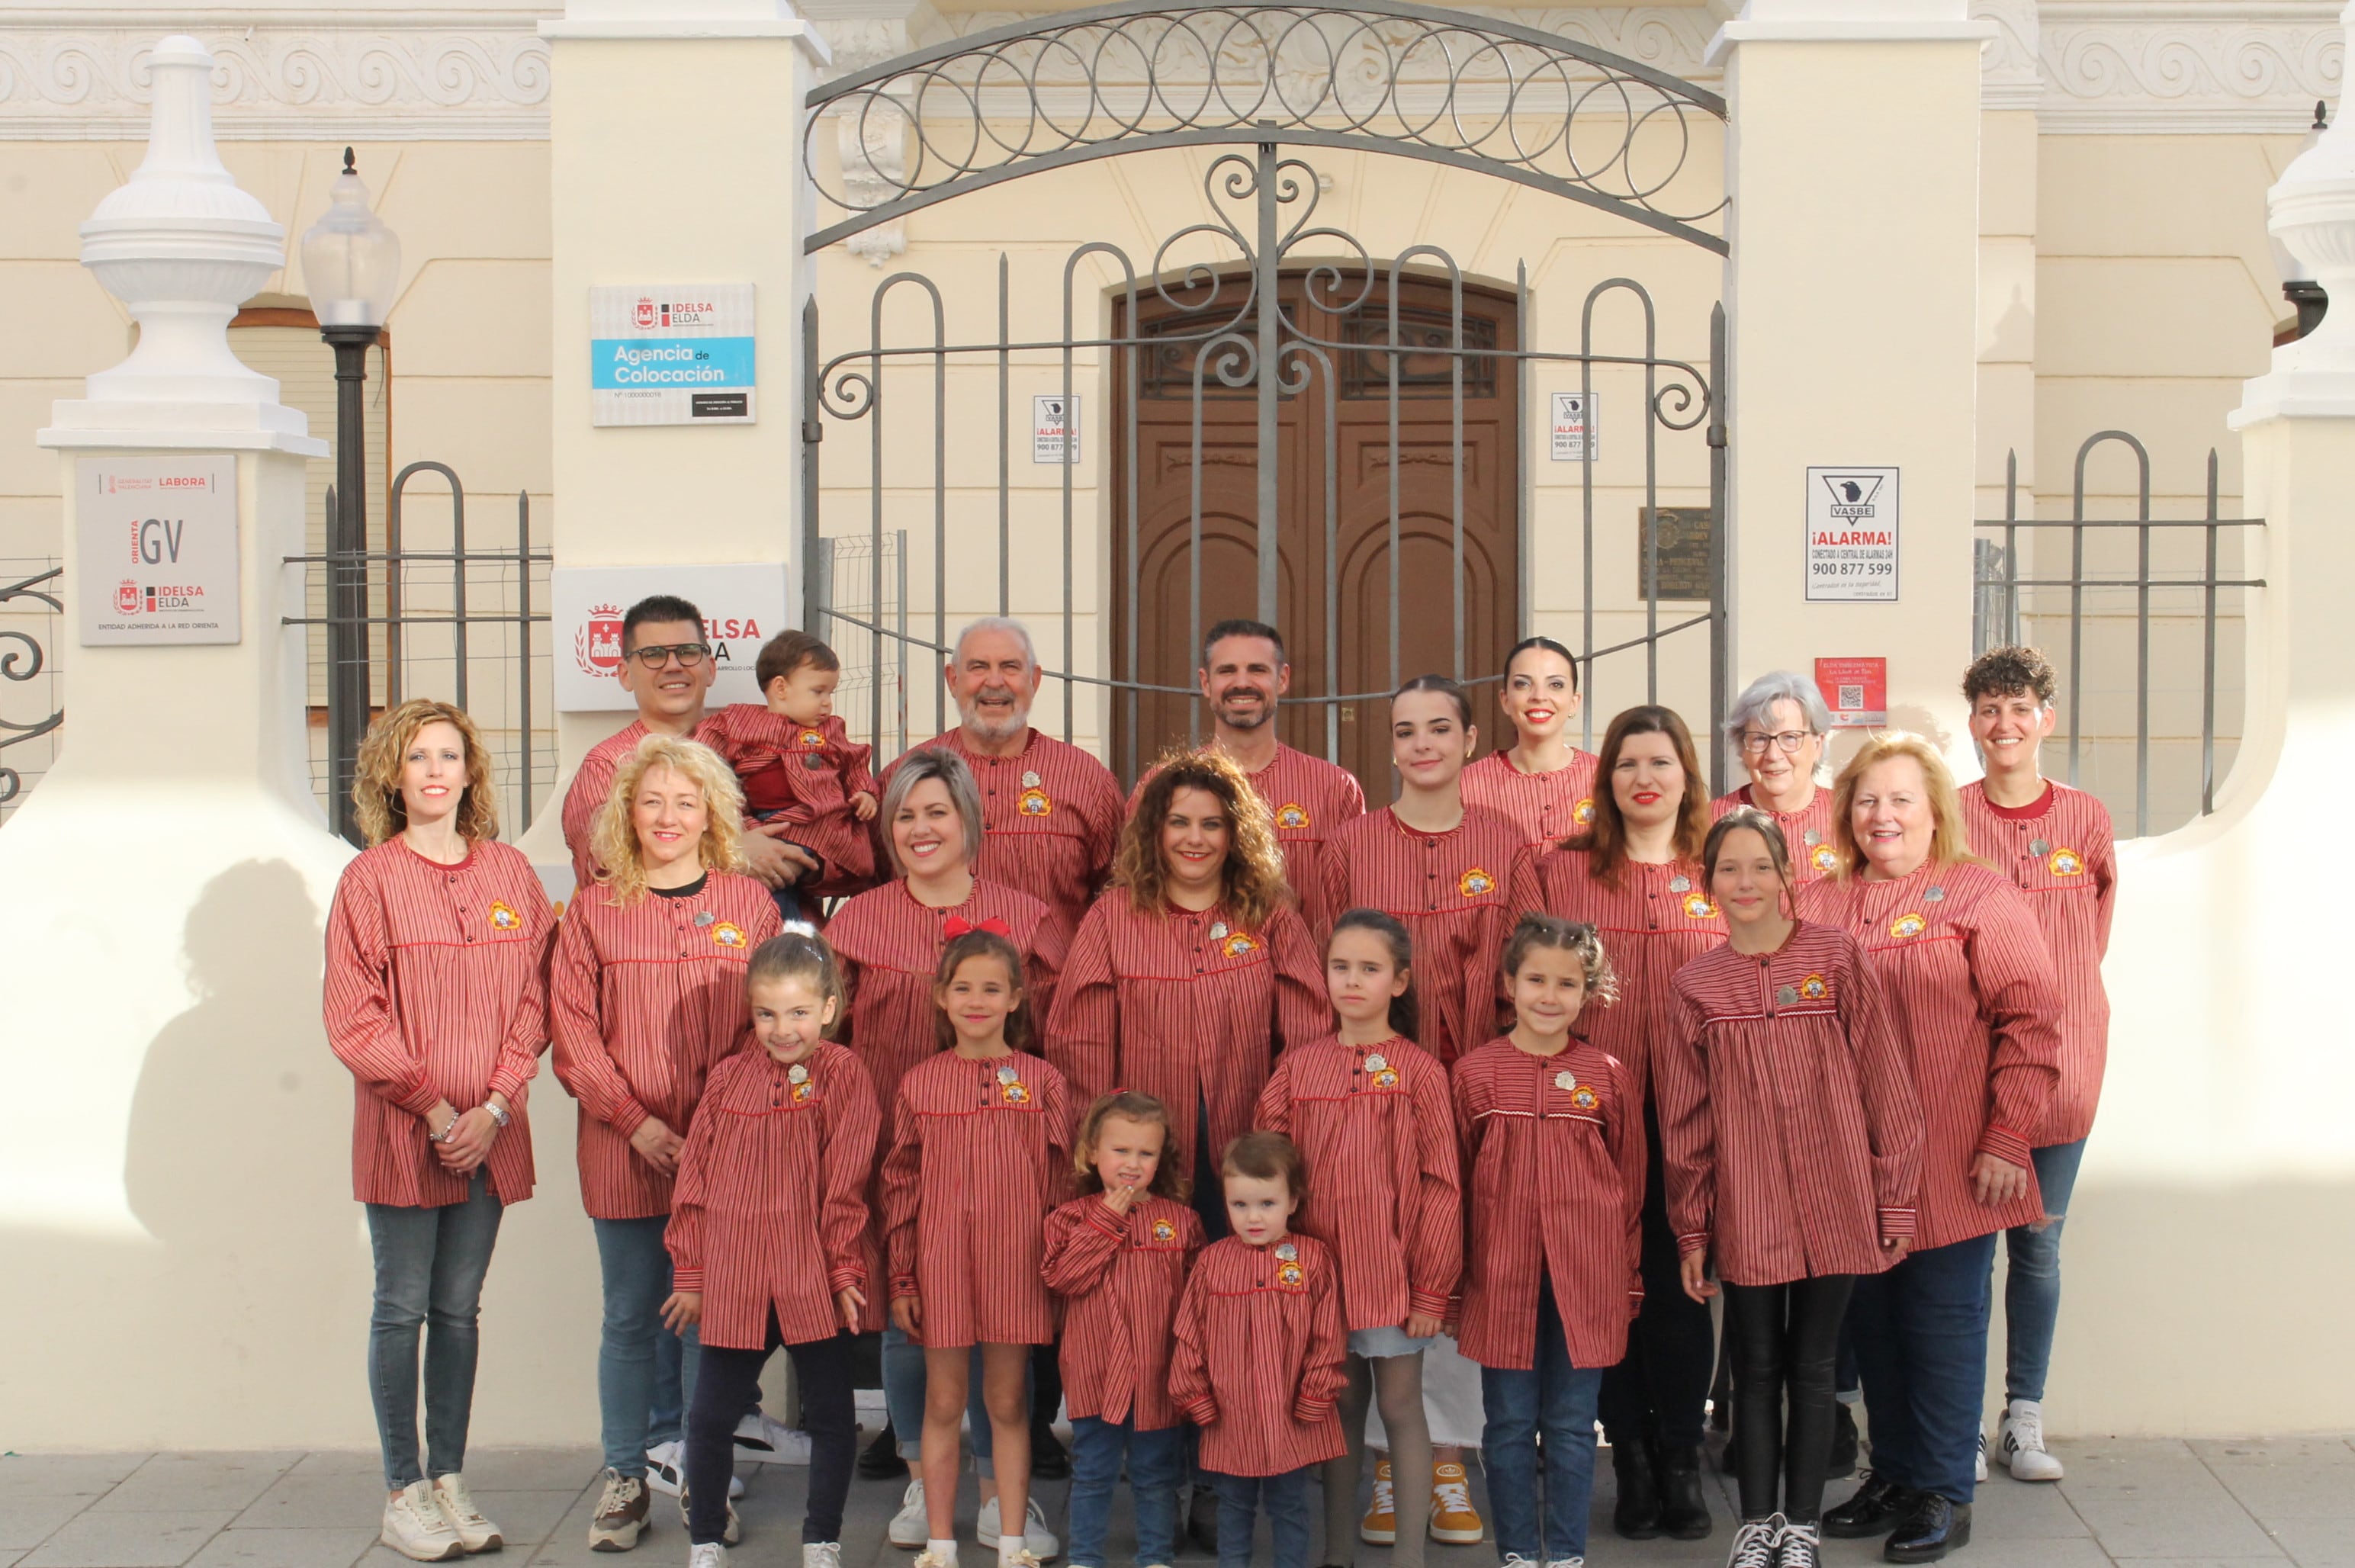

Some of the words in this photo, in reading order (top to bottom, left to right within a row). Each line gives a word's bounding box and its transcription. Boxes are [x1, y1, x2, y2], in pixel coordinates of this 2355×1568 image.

[672, 303, 714, 313] IDELSA
[672, 313, 701, 323] ELDA
[614, 344, 693, 365] Agencia
[696, 351, 709, 360] de
[615, 365, 724, 383] Colocación
[159, 477, 205, 487] LABORA
[1833, 507, 1871, 516] VASBE
[140, 519, 184, 565] GV
[1812, 532, 1891, 545] ¡ALARMA!
[1840, 549, 1859, 559] CENTRAL
[1859, 549, 1865, 559] DE
[1813, 563, 1837, 575] 900
[1840, 563, 1864, 575] 877
[1868, 563, 1892, 575] 599
[159, 586, 204, 596] IDELSA
[159, 597, 190, 608] ELDA
[702, 619, 761, 639] ELSA
